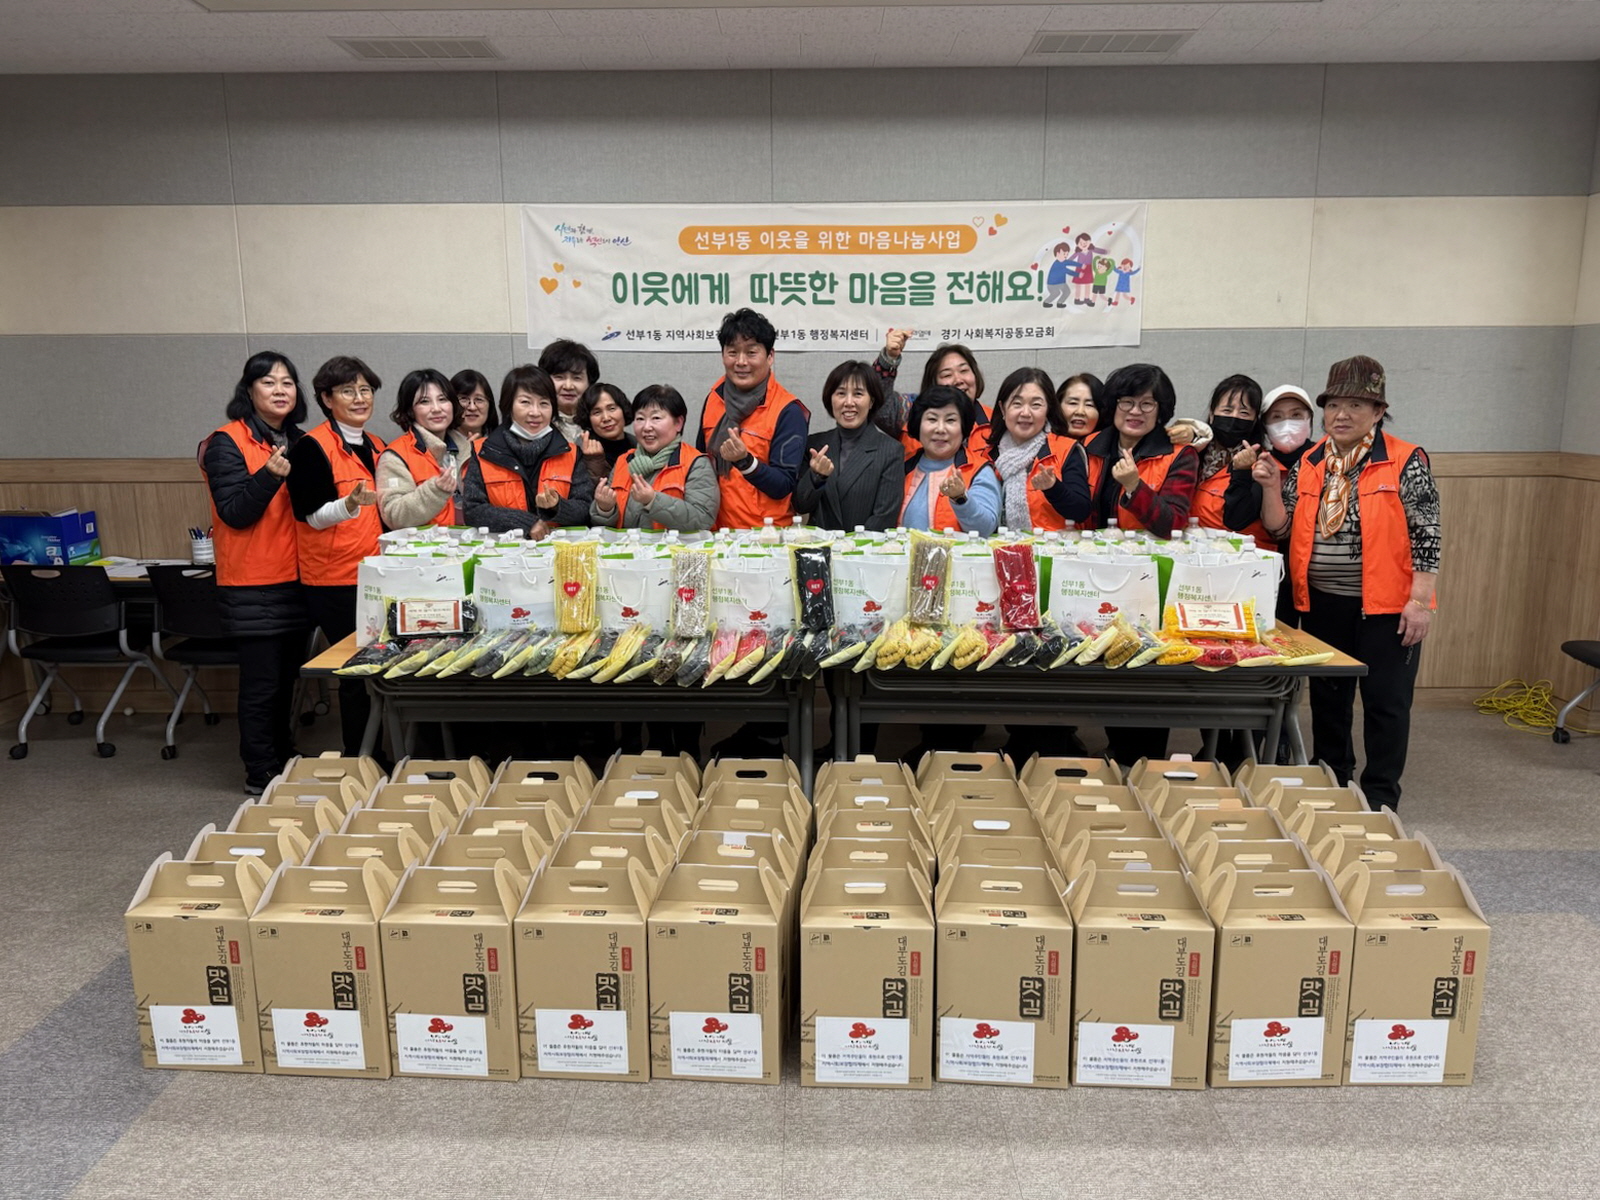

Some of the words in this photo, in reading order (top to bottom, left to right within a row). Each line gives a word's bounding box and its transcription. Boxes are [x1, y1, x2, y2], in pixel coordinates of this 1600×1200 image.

[694, 230, 750, 251] 선부1동
[760, 230, 808, 250] 이웃을
[818, 230, 851, 250] 위한
[858, 229, 961, 250] 마음나눔사업
[612, 271, 730, 306] 이웃에게
[750, 270, 839, 306] 따뜻한
[849, 270, 937, 306] 마음을
[946, 270, 1044, 304] 전해요!
[626, 329, 663, 341] 선부1동
[809, 329, 870, 341] 행정복지센터
[941, 328, 961, 340] 경기
[964, 326, 1055, 339] 사회복지공동모금회
[215, 926, 227, 964] 대부도김
[341, 931, 352, 970] 대부도김
[473, 933, 485, 972] 대부도김
[608, 932, 619, 971] 대부도김
[742, 932, 752, 972] 대부도김
[897, 936, 908, 976] 대부도김
[1035, 935, 1045, 975] 대부도김
[1175, 937, 1187, 977] 대부도김
[1316, 936, 1328, 976] 대부도김
[1451, 936, 1463, 975] 대부도김
[209, 968, 229, 1003] 맛김
[333, 974, 354, 1009] 맛김
[465, 977, 484, 1010] 맛김
[598, 976, 617, 1009] 맛김
[731, 976, 750, 1011] 맛김
[885, 981, 905, 1016] 맛김
[1022, 980, 1042, 1015] 맛김
[1162, 982, 1182, 1017] 맛김
[1302, 981, 1322, 1015] 맛김
[1435, 980, 1456, 1014] 맛김
